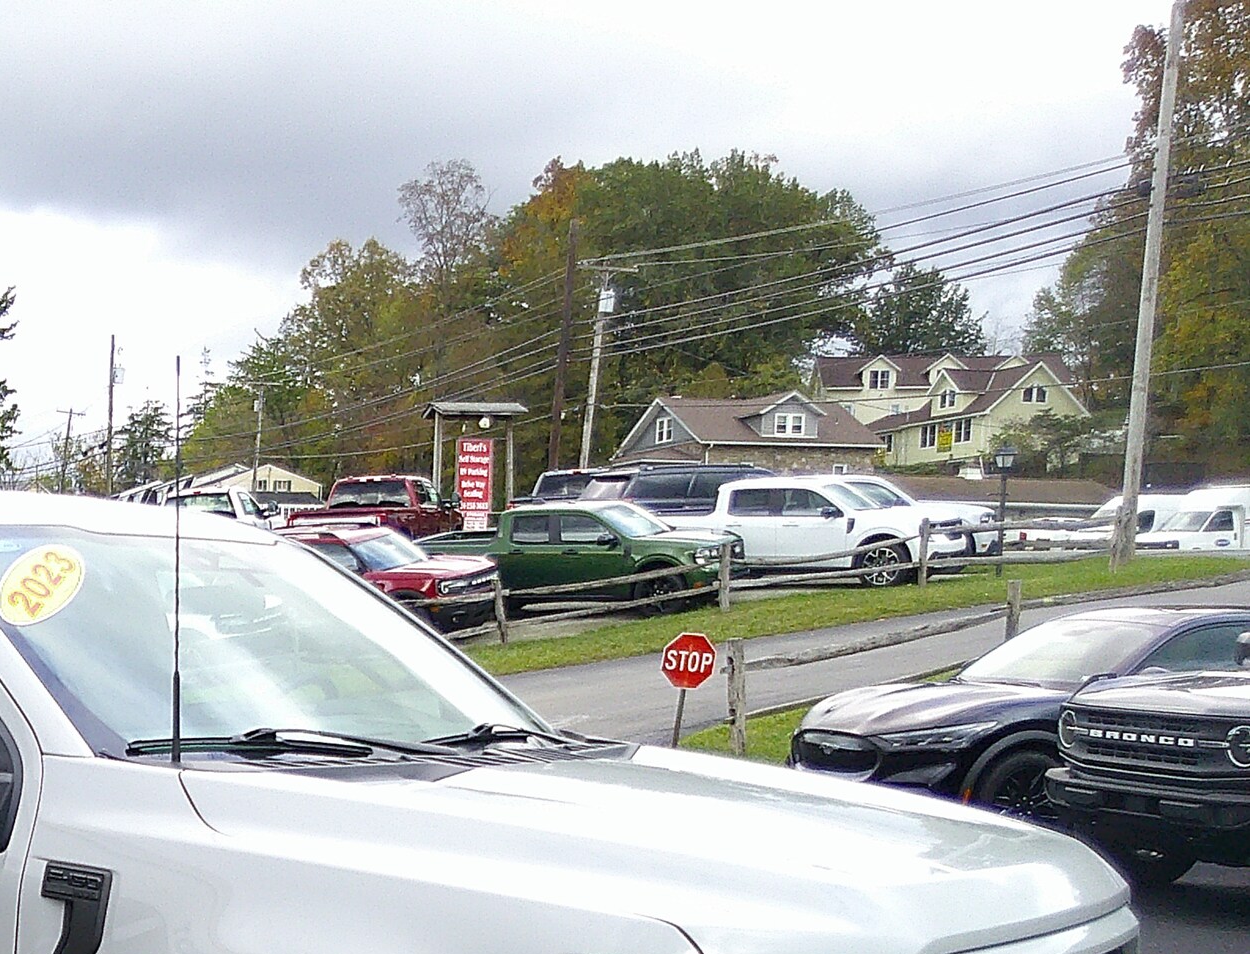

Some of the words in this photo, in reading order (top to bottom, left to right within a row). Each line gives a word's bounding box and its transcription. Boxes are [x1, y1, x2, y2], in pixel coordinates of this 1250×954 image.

[470, 455, 490, 464] Storage
[468, 467, 488, 477] Parking
[7, 550, 75, 618] 2023
[664, 649, 713, 673] STOP
[1088, 728, 1196, 748] BRONCO
